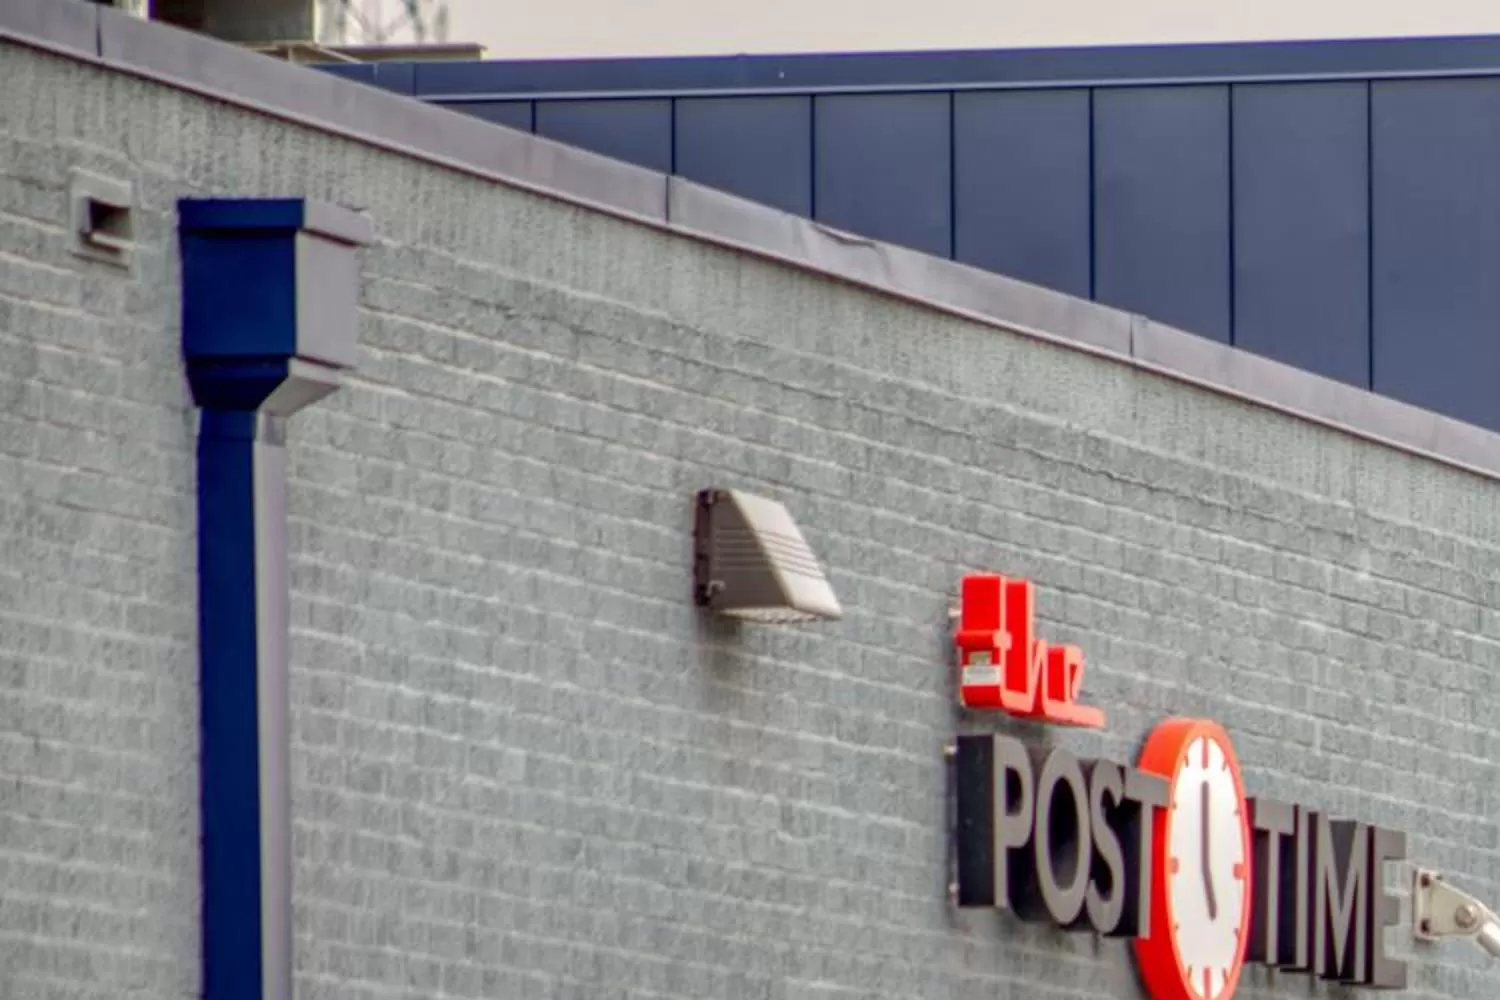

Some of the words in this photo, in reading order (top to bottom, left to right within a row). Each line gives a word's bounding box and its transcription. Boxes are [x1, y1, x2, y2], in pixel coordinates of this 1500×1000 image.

[962, 574, 1105, 728] the
[990, 732, 1170, 940] POST
[1250, 798, 1407, 990] TIME
